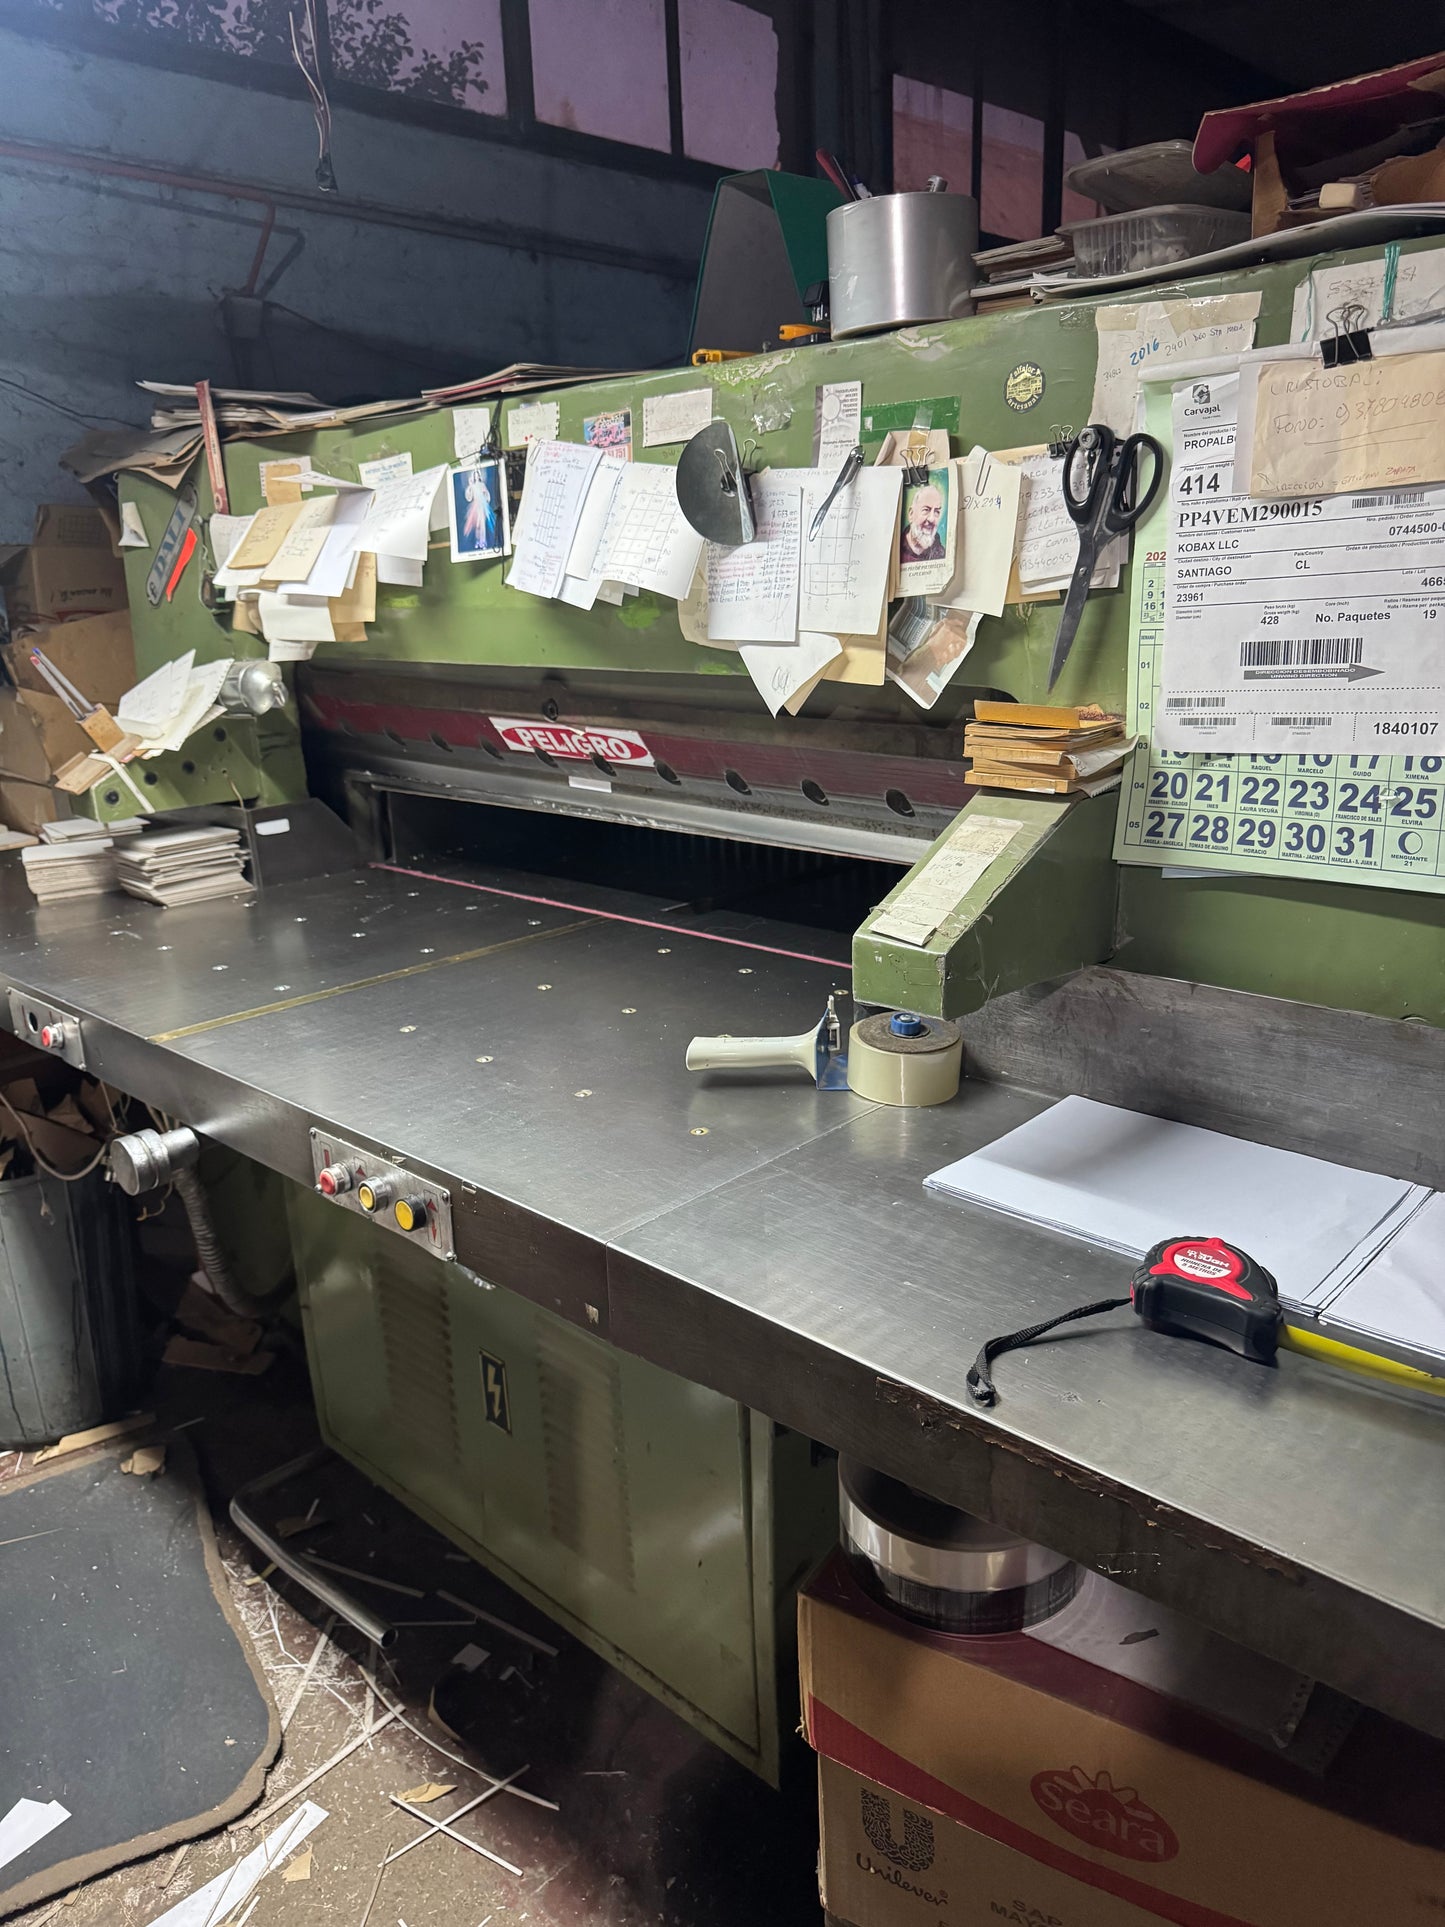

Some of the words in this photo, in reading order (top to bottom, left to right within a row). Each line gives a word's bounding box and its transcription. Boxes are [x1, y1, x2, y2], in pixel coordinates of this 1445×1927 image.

[1129, 338, 1160, 366] 2016
[1007, 394, 1039, 410] artesanal
[1184, 404, 1221, 416] Carvajal
[1184, 435, 1237, 450] PROPALB
[1179, 472, 1220, 495] 414
[1178, 500, 1323, 528] PP4VEM290015
[1178, 541, 1216, 553] KOBAX
[1218, 539, 1240, 550] LLC
[1402, 540, 1429, 548] Production
[1145, 551, 1166, 561] 202
[1296, 559, 1310, 570] CL
[1177, 565, 1232, 578] SANTIAGO
[1148, 579, 1154, 588] 2
[1147, 591, 1154, 599] 9
[1177, 592, 1204, 602] 23961
[1144, 602, 1156, 610] 16
[1260, 615, 1279, 625] 428
[1315, 613, 1334, 623] No.
[1337, 612, 1391, 624] Paquetes
[1423, 609, 1437, 620] 19
[1139, 702, 1150, 710] 02
[1373, 722, 1439, 735] 1840107
[514, 728, 632, 759] PELIGRO
[1133, 782, 1145, 790] 04
[1150, 771, 1188, 800] 20
[1194, 773, 1230, 803] 21
[1240, 777, 1280, 806] 22
[1287, 779, 1329, 811] 23
[1337, 783, 1382, 815] 24
[1390, 786, 1438, 819] 25
[1145, 811, 1185, 838] 27
[1190, 814, 1229, 844] 28
[1236, 818, 1276, 849] 29
[1285, 822, 1326, 853] 30
[1334, 826, 1375, 858] 31
[1390, 854, 1428, 862] MENGUANTE
[1036, 1778, 1166, 1858] Seara
[856, 1852, 948, 1906] Unilever
